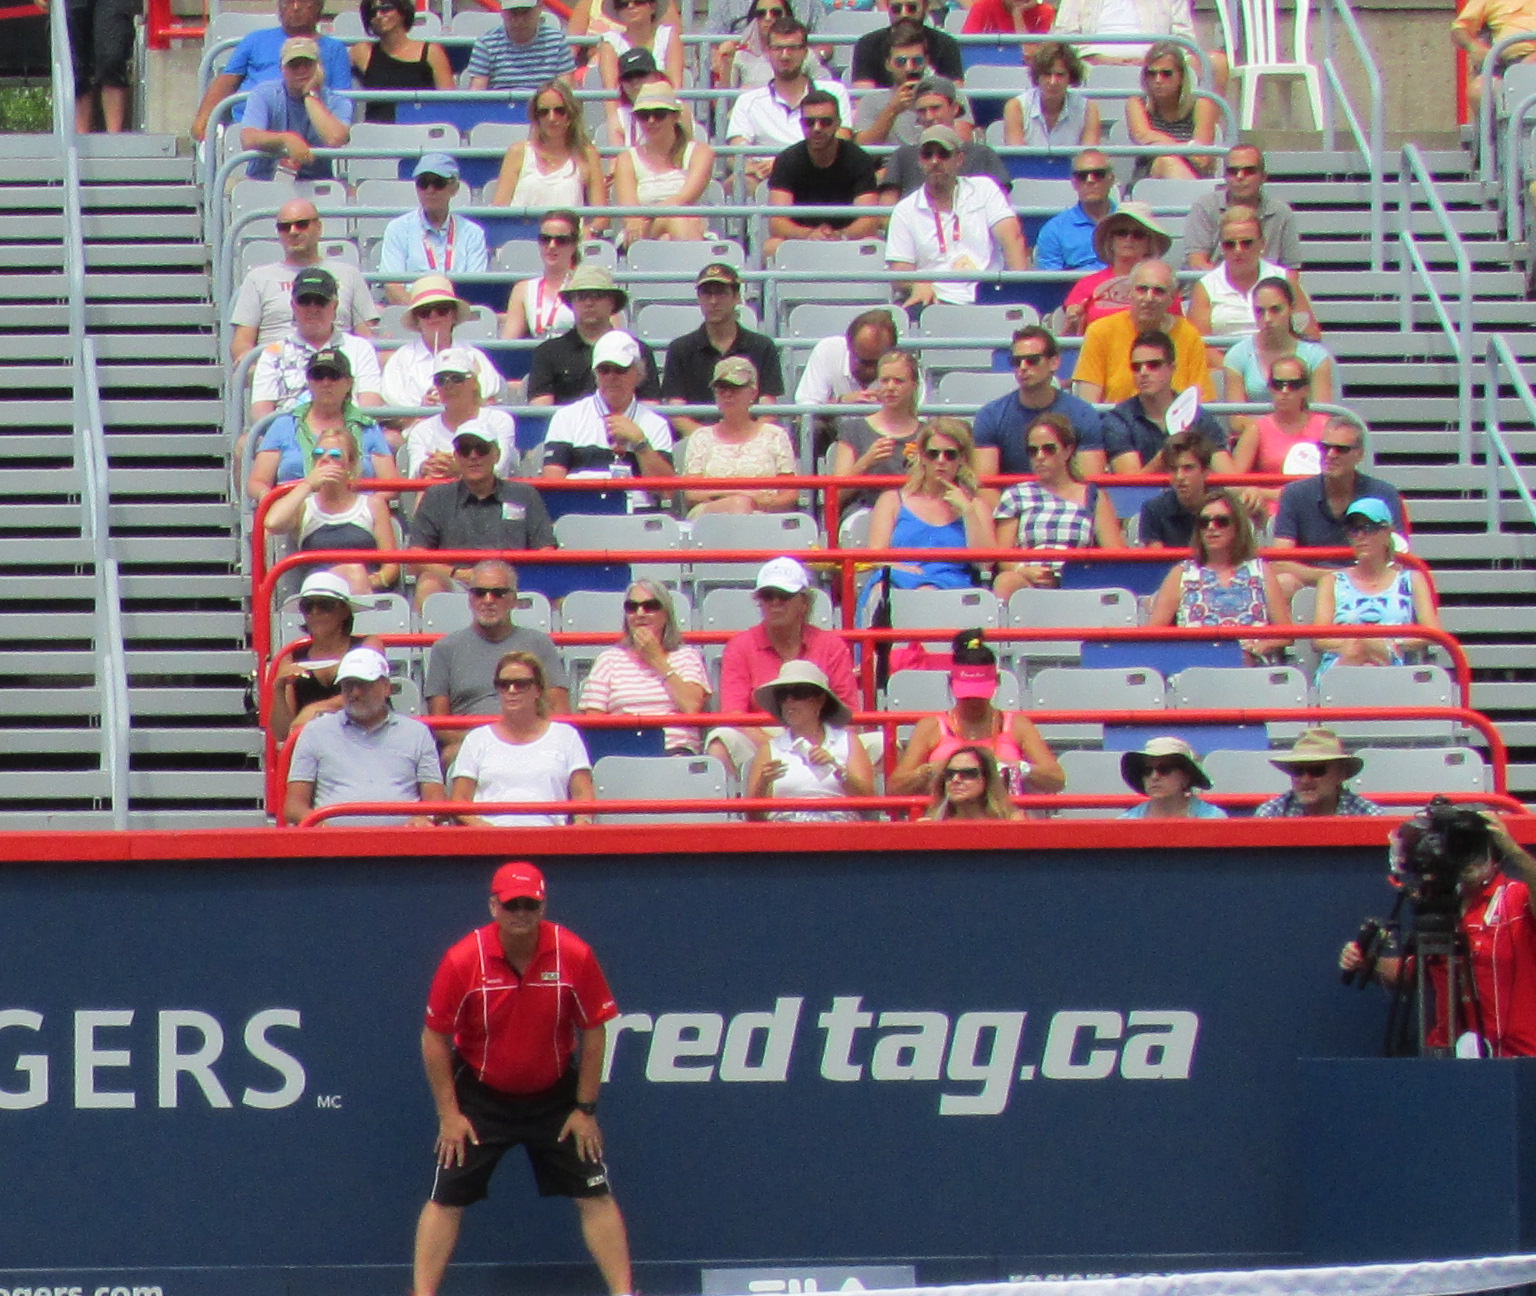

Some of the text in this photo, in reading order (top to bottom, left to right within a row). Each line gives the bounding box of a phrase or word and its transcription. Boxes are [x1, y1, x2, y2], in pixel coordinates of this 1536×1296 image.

[601, 996, 1200, 1116] red tag.ca
[318, 1095, 343, 1110] MC
